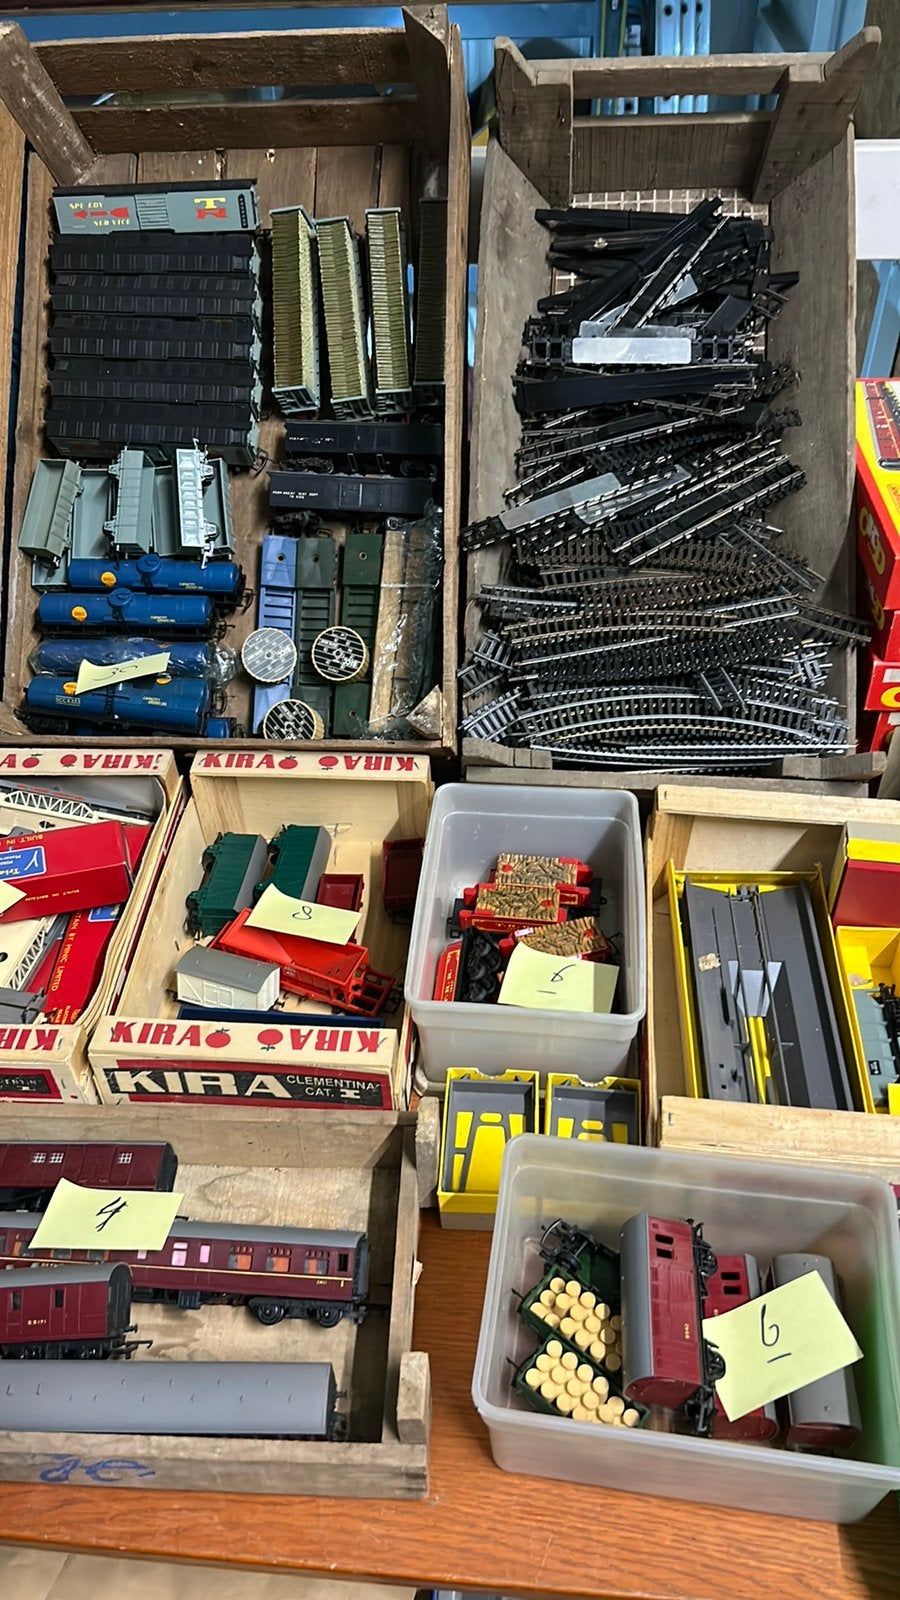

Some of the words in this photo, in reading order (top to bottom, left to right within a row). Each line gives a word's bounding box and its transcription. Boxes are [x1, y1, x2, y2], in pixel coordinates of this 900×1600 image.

[203, 753, 275, 769] KIRA
[343, 754, 414, 771] KIRA
[51, 965, 66, 992] LIMITED
[110, 1021, 201, 1047] KIRA
[290, 1028, 380, 1053] KIRA
[114, 1069, 293, 1099] KIRA
[286, 1074, 377, 1090] CLEMENTINA
[305, 1086, 334, 1098] CAT.
[760, 1304, 780, 1347] 6
